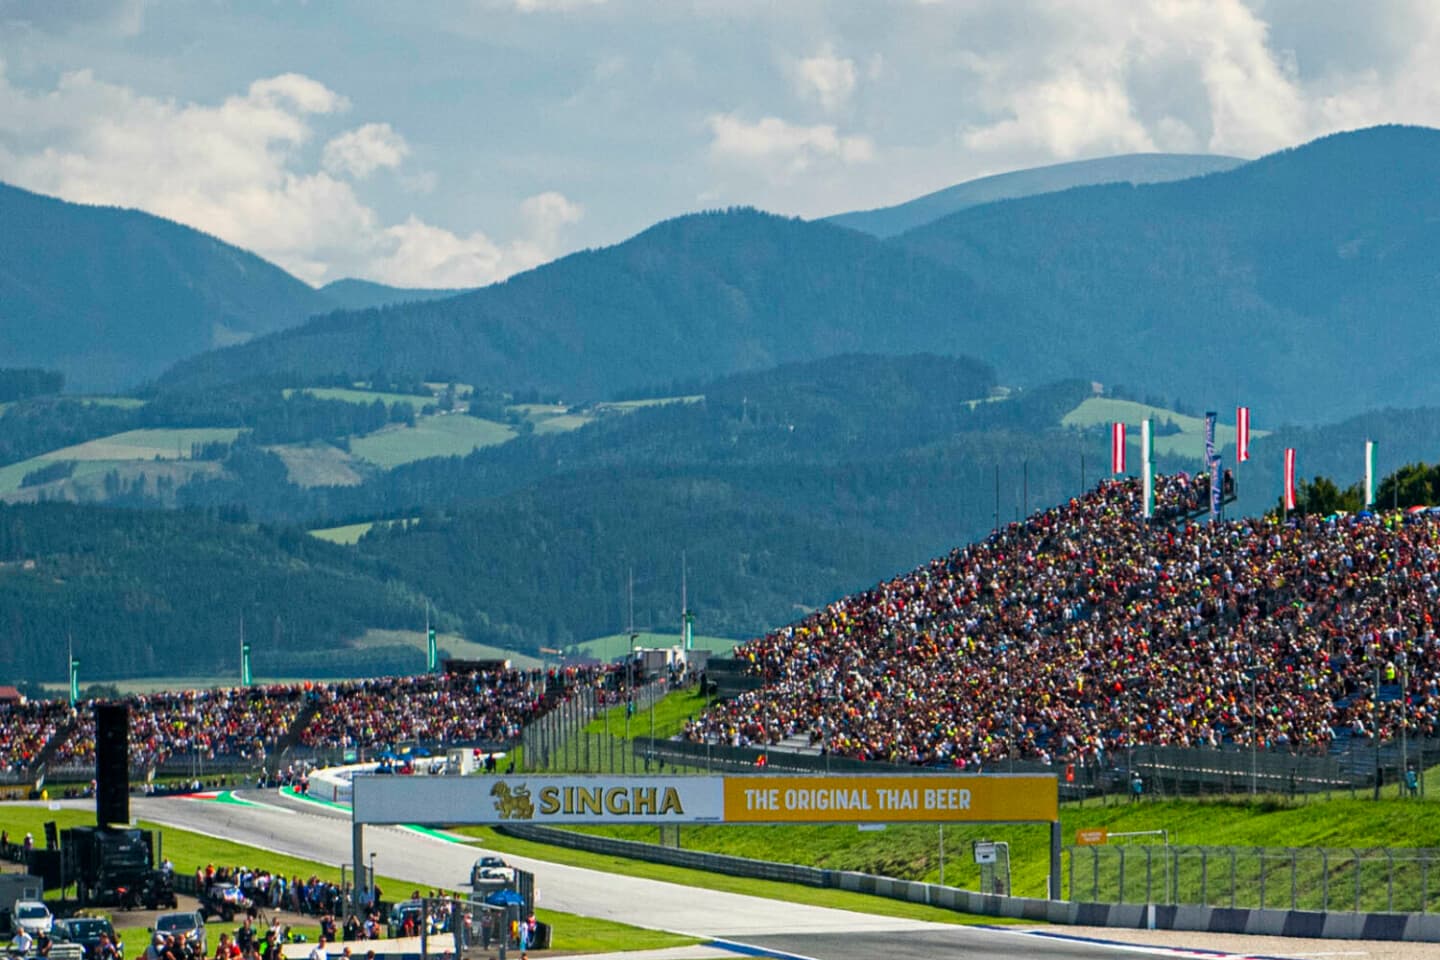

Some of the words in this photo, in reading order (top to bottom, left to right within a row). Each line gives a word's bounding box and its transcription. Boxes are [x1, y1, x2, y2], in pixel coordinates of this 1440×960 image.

[540, 786, 684, 816] SINGHA
[744, 788, 779, 810] THE
[785, 788, 872, 810] ORIGINAL
[876, 788, 919, 810] THAI
[925, 787, 971, 810] BEER
